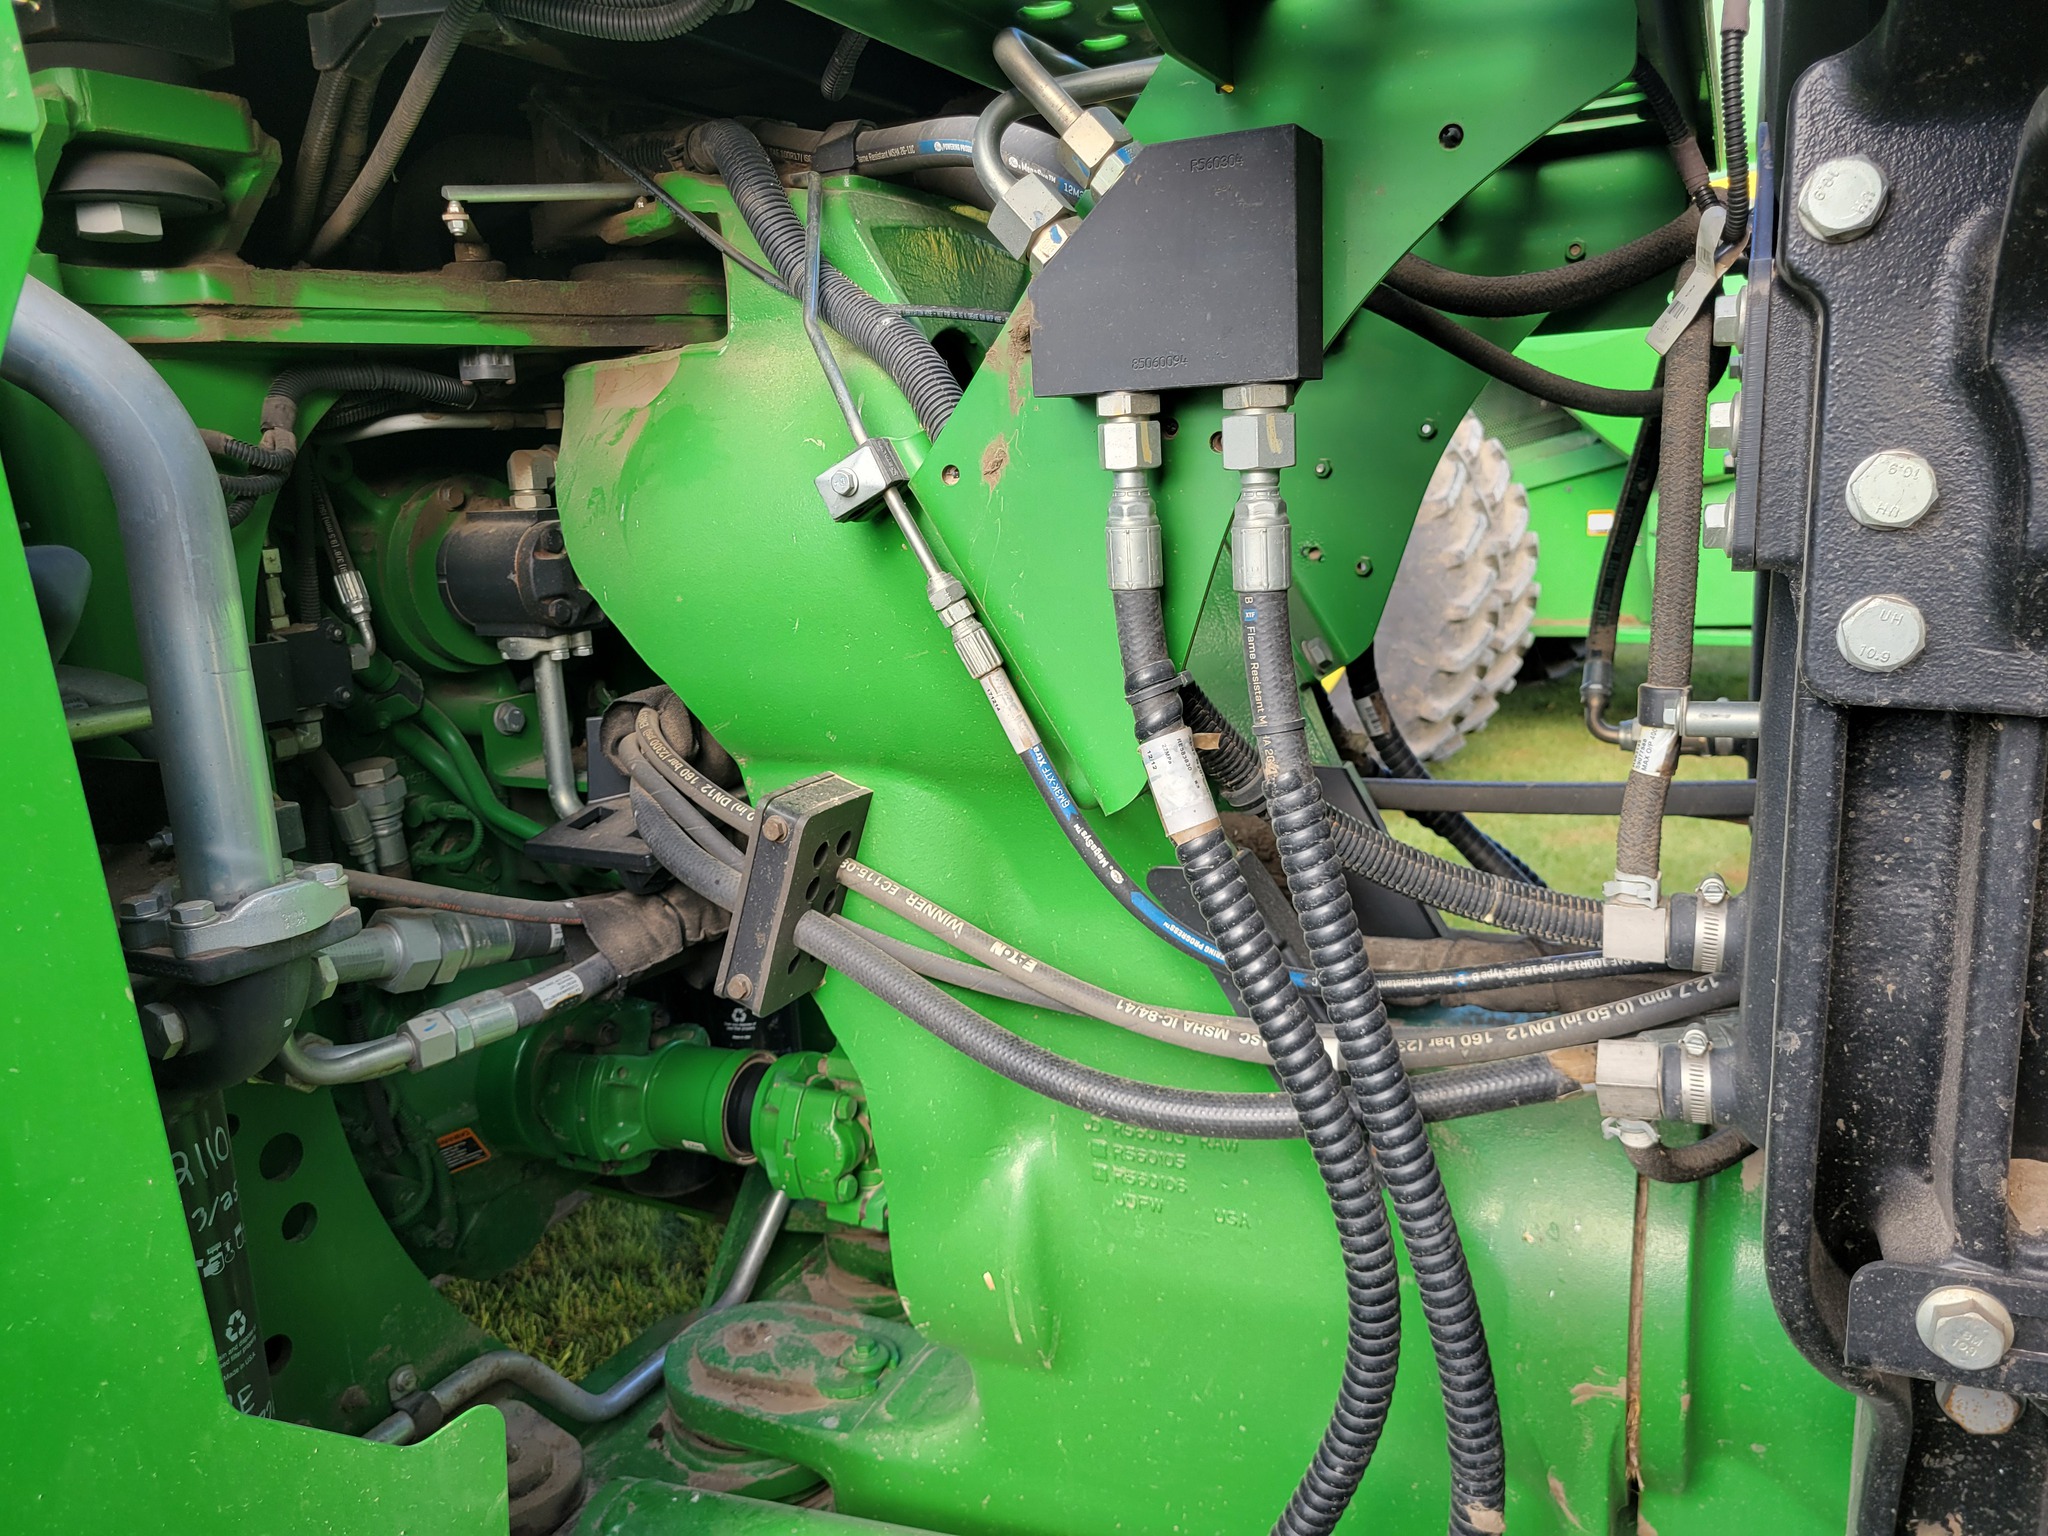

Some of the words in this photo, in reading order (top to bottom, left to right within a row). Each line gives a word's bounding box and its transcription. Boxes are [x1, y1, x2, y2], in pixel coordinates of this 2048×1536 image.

[1191, 153, 1244, 173] R560304
[1131, 355, 1189, 371] 85060094
[1888, 463, 1921, 481] 10.9
[1875, 502, 1900, 518] UH
[1879, 608, 1904, 626] UH
[1246, 626, 1257, 660] Flame
[1859, 644, 1891, 664] 10.9
[1250, 661, 1266, 713] Resistant
[667, 757, 685, 772] bar
[1641, 755, 1651, 771] MAX
[680, 769, 699, 785] 160
[700, 783, 732, 808] DN12
[905, 893, 965, 937] WINNER
[1377, 975, 1424, 988] Resistant
[1427, 974, 1453, 987] Flame
[1483, 966, 1504, 981] Type
[1680, 974, 1720, 999] 12.7
[1638, 989, 1673, 1007] mm
[1116, 999, 1178, 1029] IC-84/41
[1586, 1000, 1635, 1023] (0.50
[1183, 1019, 1230, 1041] MSHA
[1506, 1019, 1556, 1041] DN12
[1559, 1010, 1584, 1032] in)
[1238, 1032, 1267, 1047] SC
[1428, 1032, 1455, 1049] bar
[1460, 1031, 1493, 1048] 160
